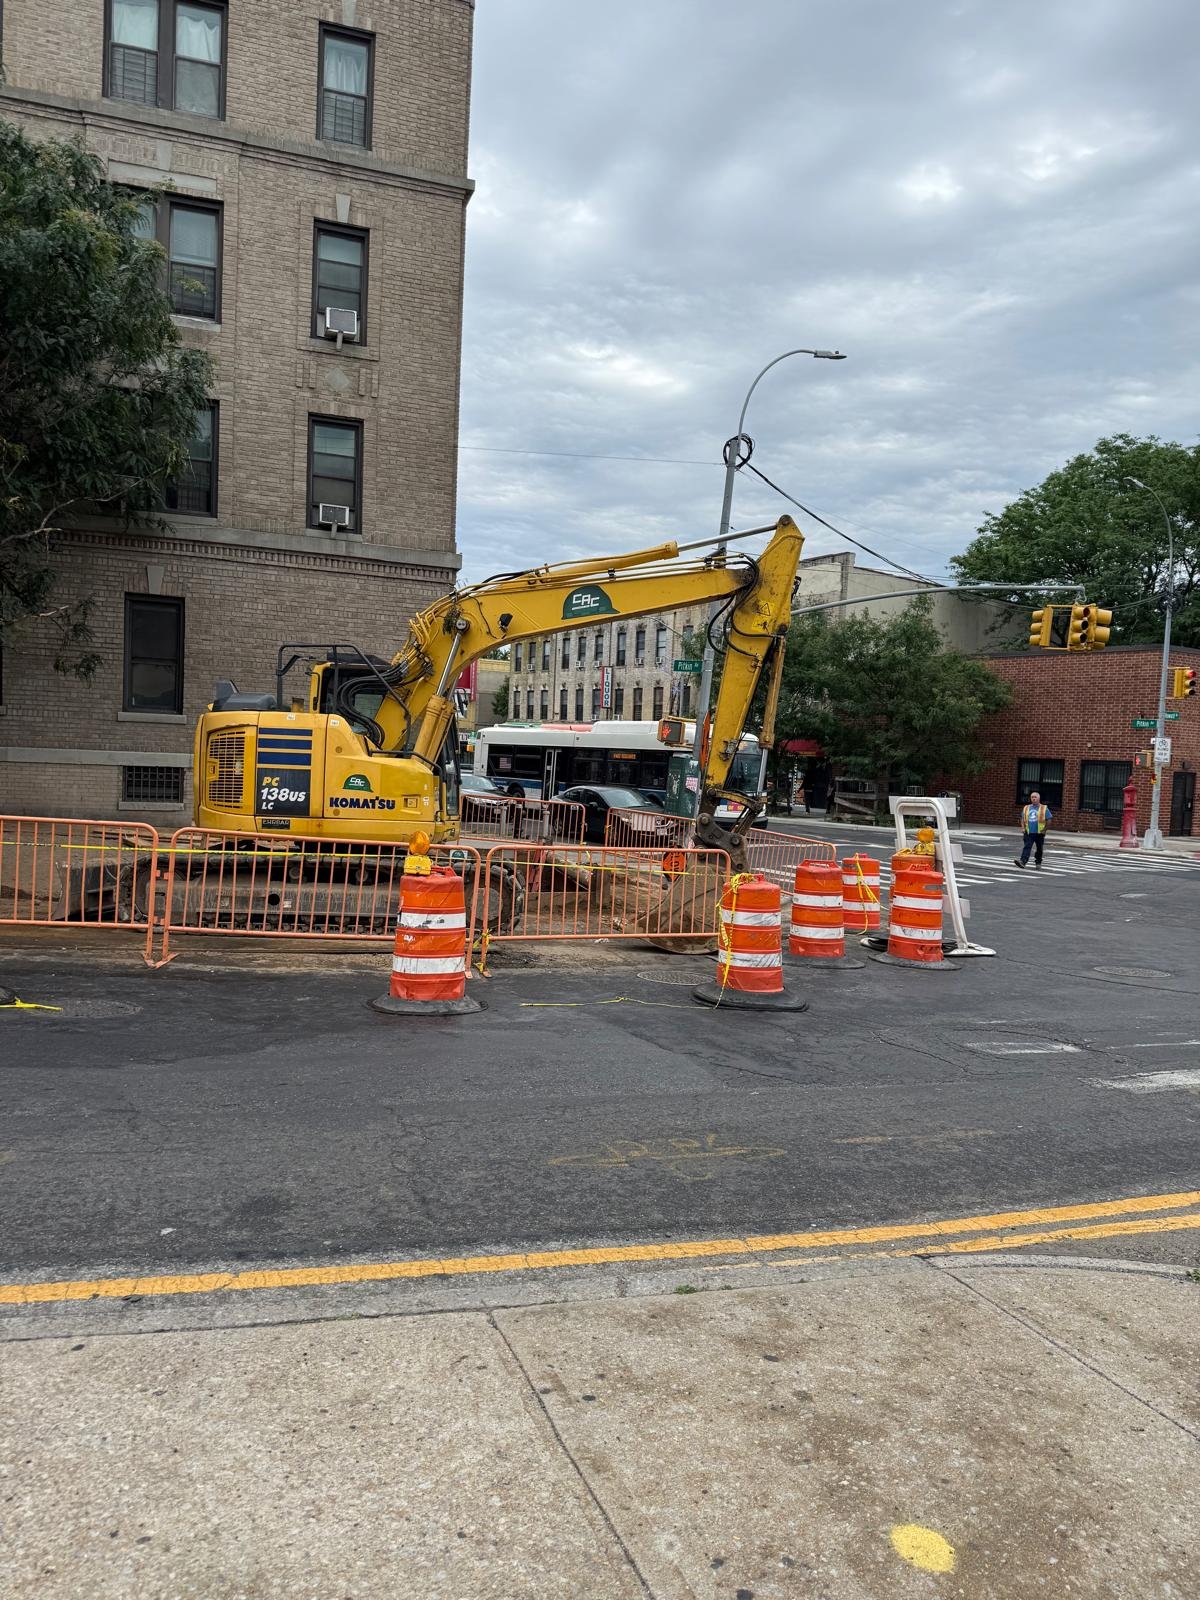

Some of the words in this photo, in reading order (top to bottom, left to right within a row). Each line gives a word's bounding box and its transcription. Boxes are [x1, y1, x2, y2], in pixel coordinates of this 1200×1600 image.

[572, 594, 600, 607] CAC
[262, 776, 280, 787] PC
[261, 801, 275, 810] LC
[329, 796, 396, 810] KOMATSU
